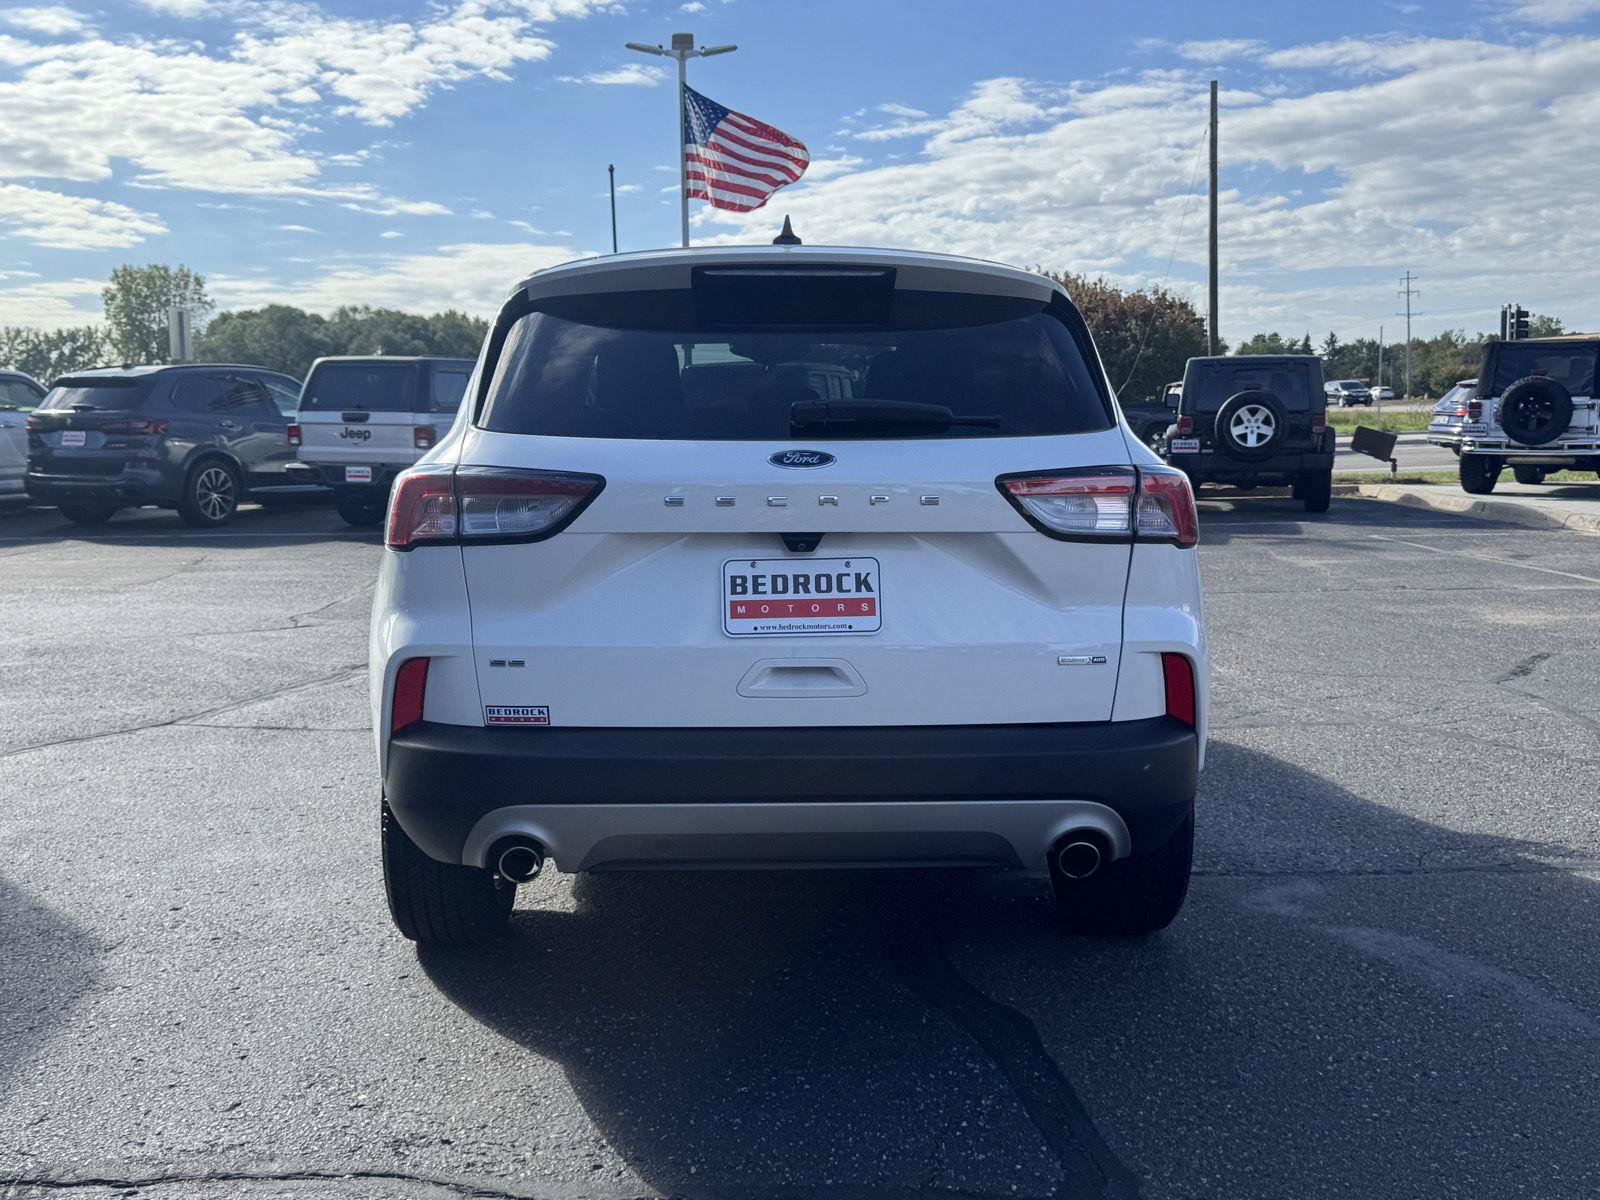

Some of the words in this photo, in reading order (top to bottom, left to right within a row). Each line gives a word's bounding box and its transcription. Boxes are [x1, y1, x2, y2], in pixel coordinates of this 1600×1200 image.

[340, 427, 371, 441] Jeep
[783, 452, 821, 463] Ford
[664, 495, 939, 507] ESCAPE
[730, 572, 874, 595] BEDROCK
[737, 603, 869, 614] MOTORS
[760, 623, 847, 631] www.bedrockmotors.com
[488, 708, 546, 716] BEDROCK
